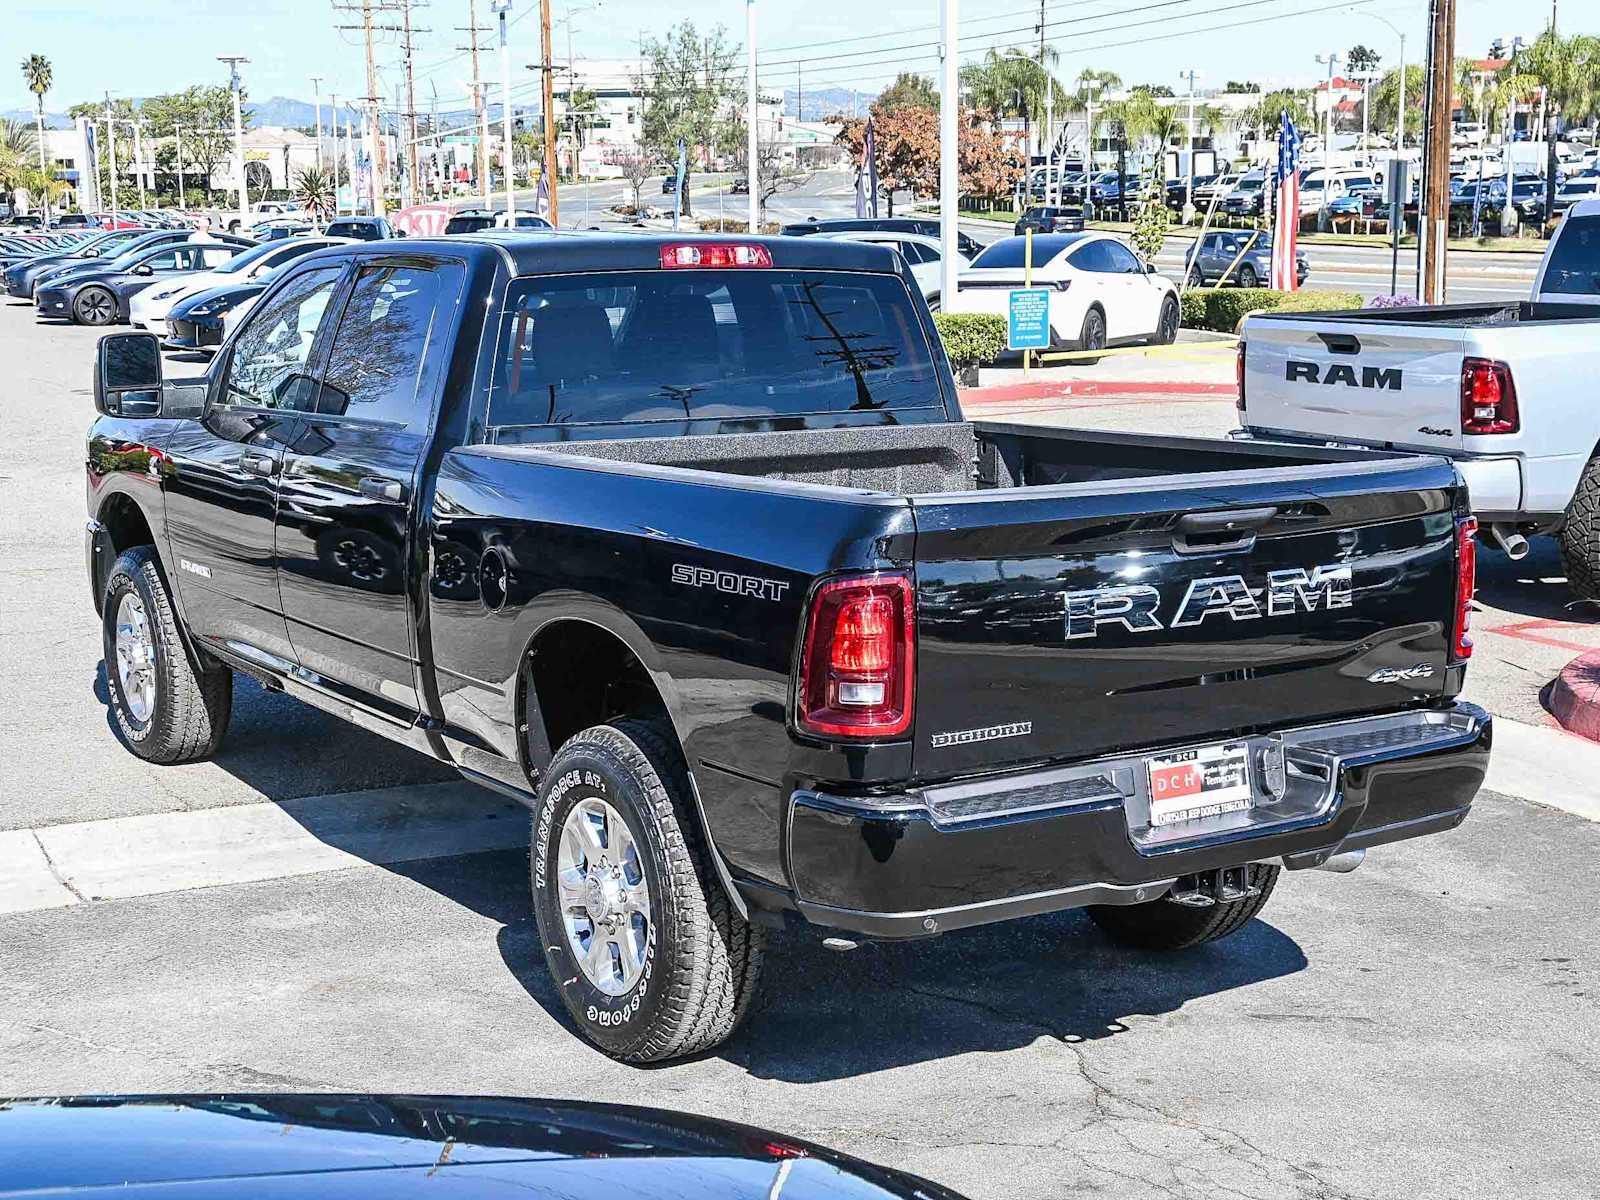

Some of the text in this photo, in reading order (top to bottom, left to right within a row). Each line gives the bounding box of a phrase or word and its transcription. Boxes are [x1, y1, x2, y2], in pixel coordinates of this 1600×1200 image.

[1285, 360, 1403, 391] RAM
[671, 563, 790, 602] SPORT
[1064, 562, 1353, 641] RAM
[931, 721, 1032, 748] BIGHORN
[535, 770, 582, 889] TRANSFORCE
